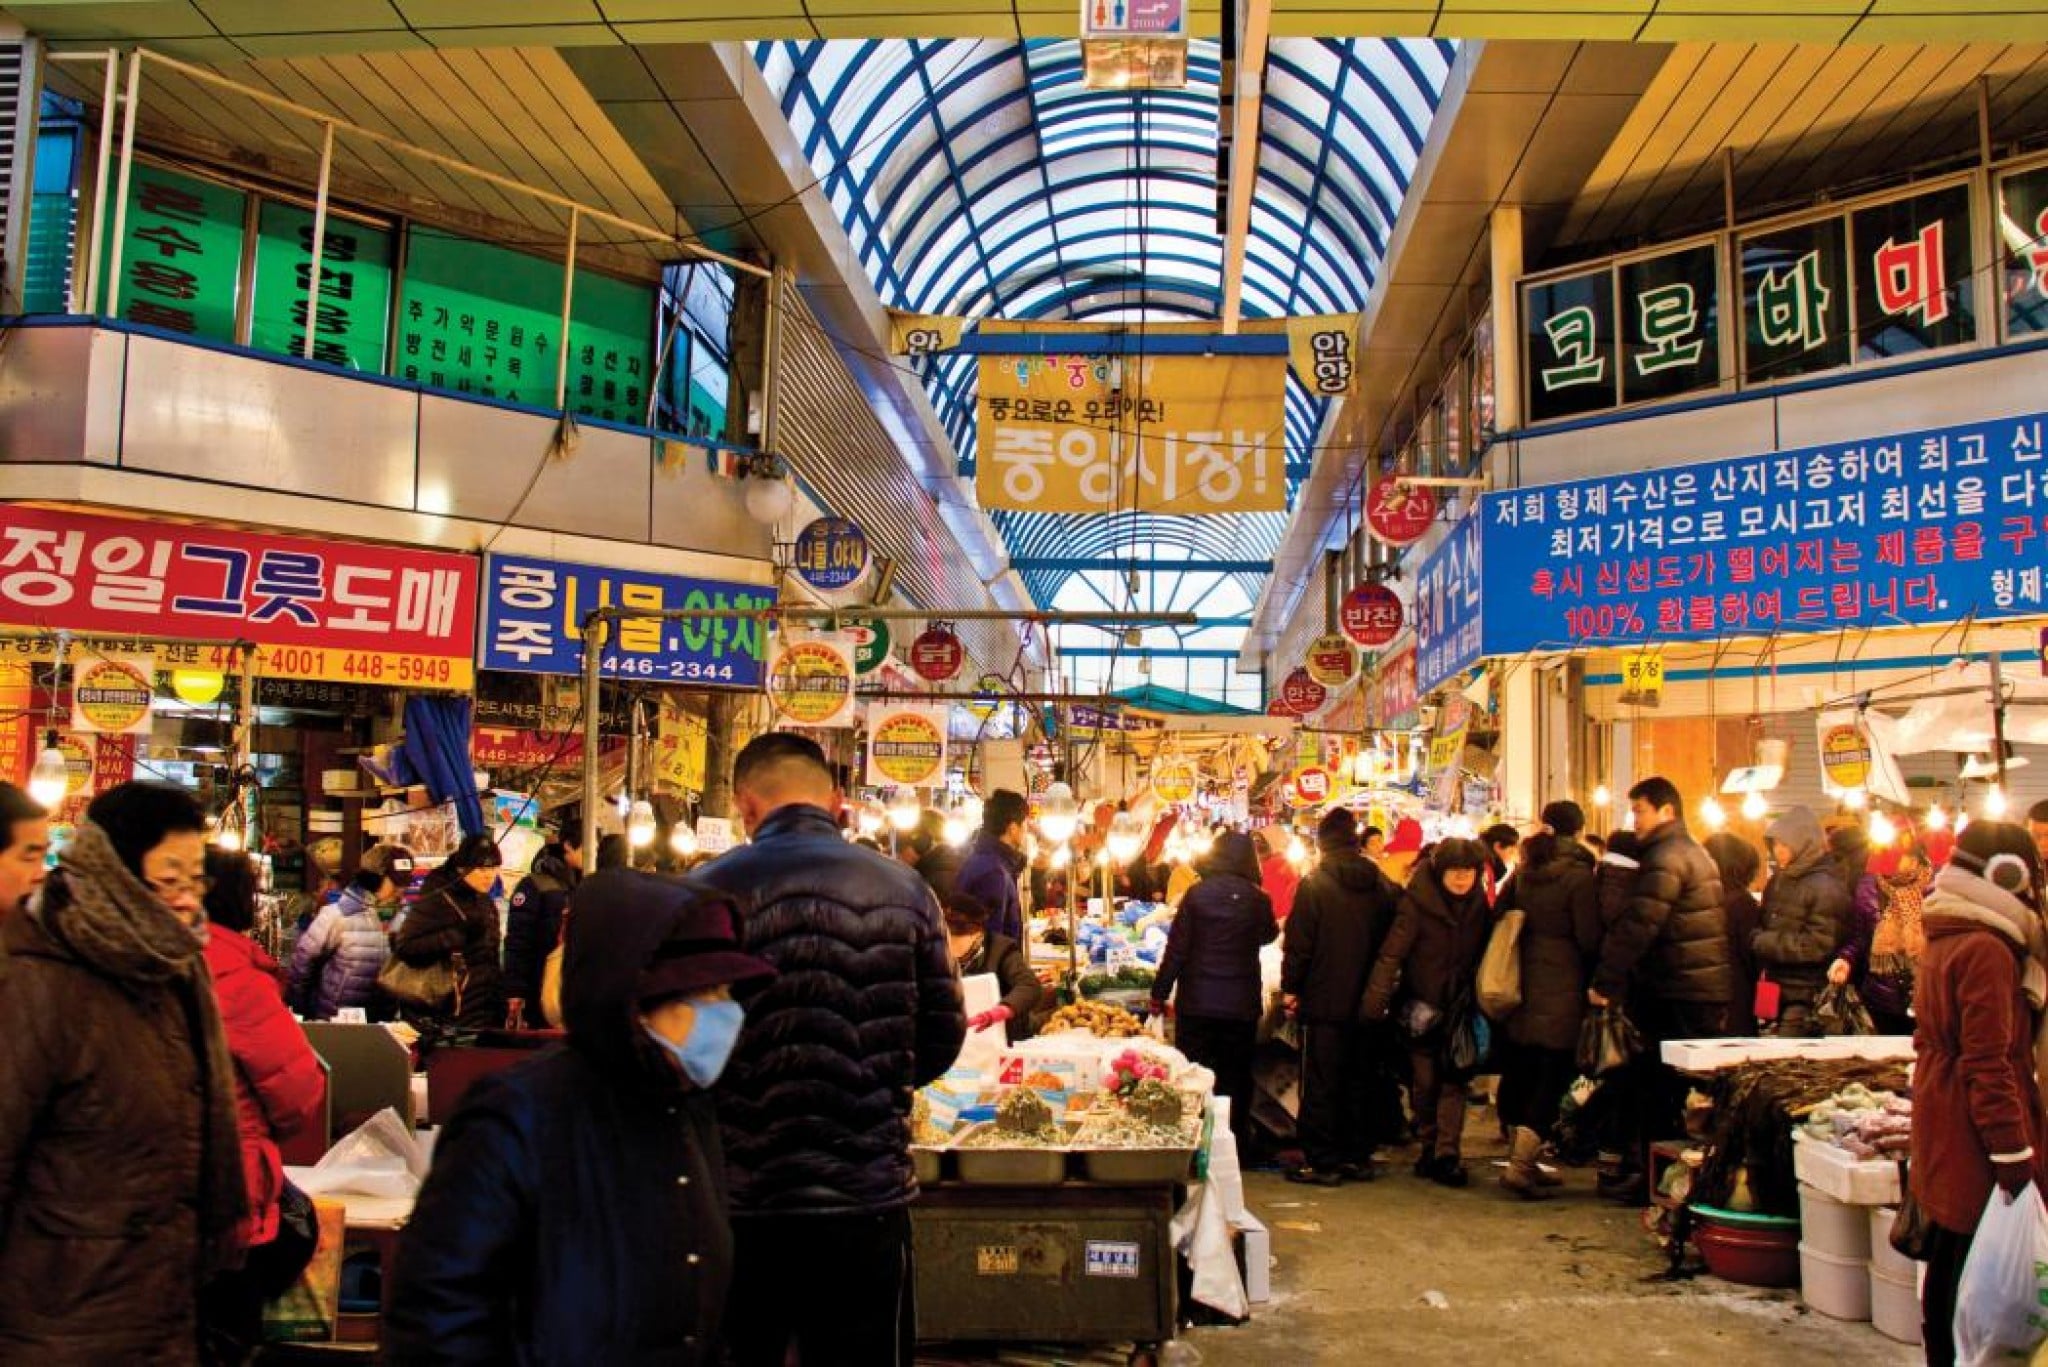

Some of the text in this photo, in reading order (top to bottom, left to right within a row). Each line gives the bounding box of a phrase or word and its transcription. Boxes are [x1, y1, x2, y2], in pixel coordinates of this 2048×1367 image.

[1310, 331, 1352, 393] 안양
[993, 428, 1267, 503] 중앙시장!
[1496, 492, 1546, 527] 저희
[1556, 472, 1699, 521] 형제수산은
[1710, 442, 1903, 501] 산지직송하여
[1919, 433, 1989, 472] 최고
[1550, 468, 2048, 558] 최저 가격으로 모시고저 최선을 다
[1, 526, 461, 638] 정일그릇도매
[1531, 514, 2048, 600] 혹시 신선도가 떨어지는 제품을 구
[1990, 566, 2048, 608] 형제
[1565, 574, 1948, 638] 100% 환불하여 드립니다.
[210, 644, 326, 675] 44-4001
[343, 655, 450, 682] 448-5949
[602, 656, 734, 680] 446-2344
